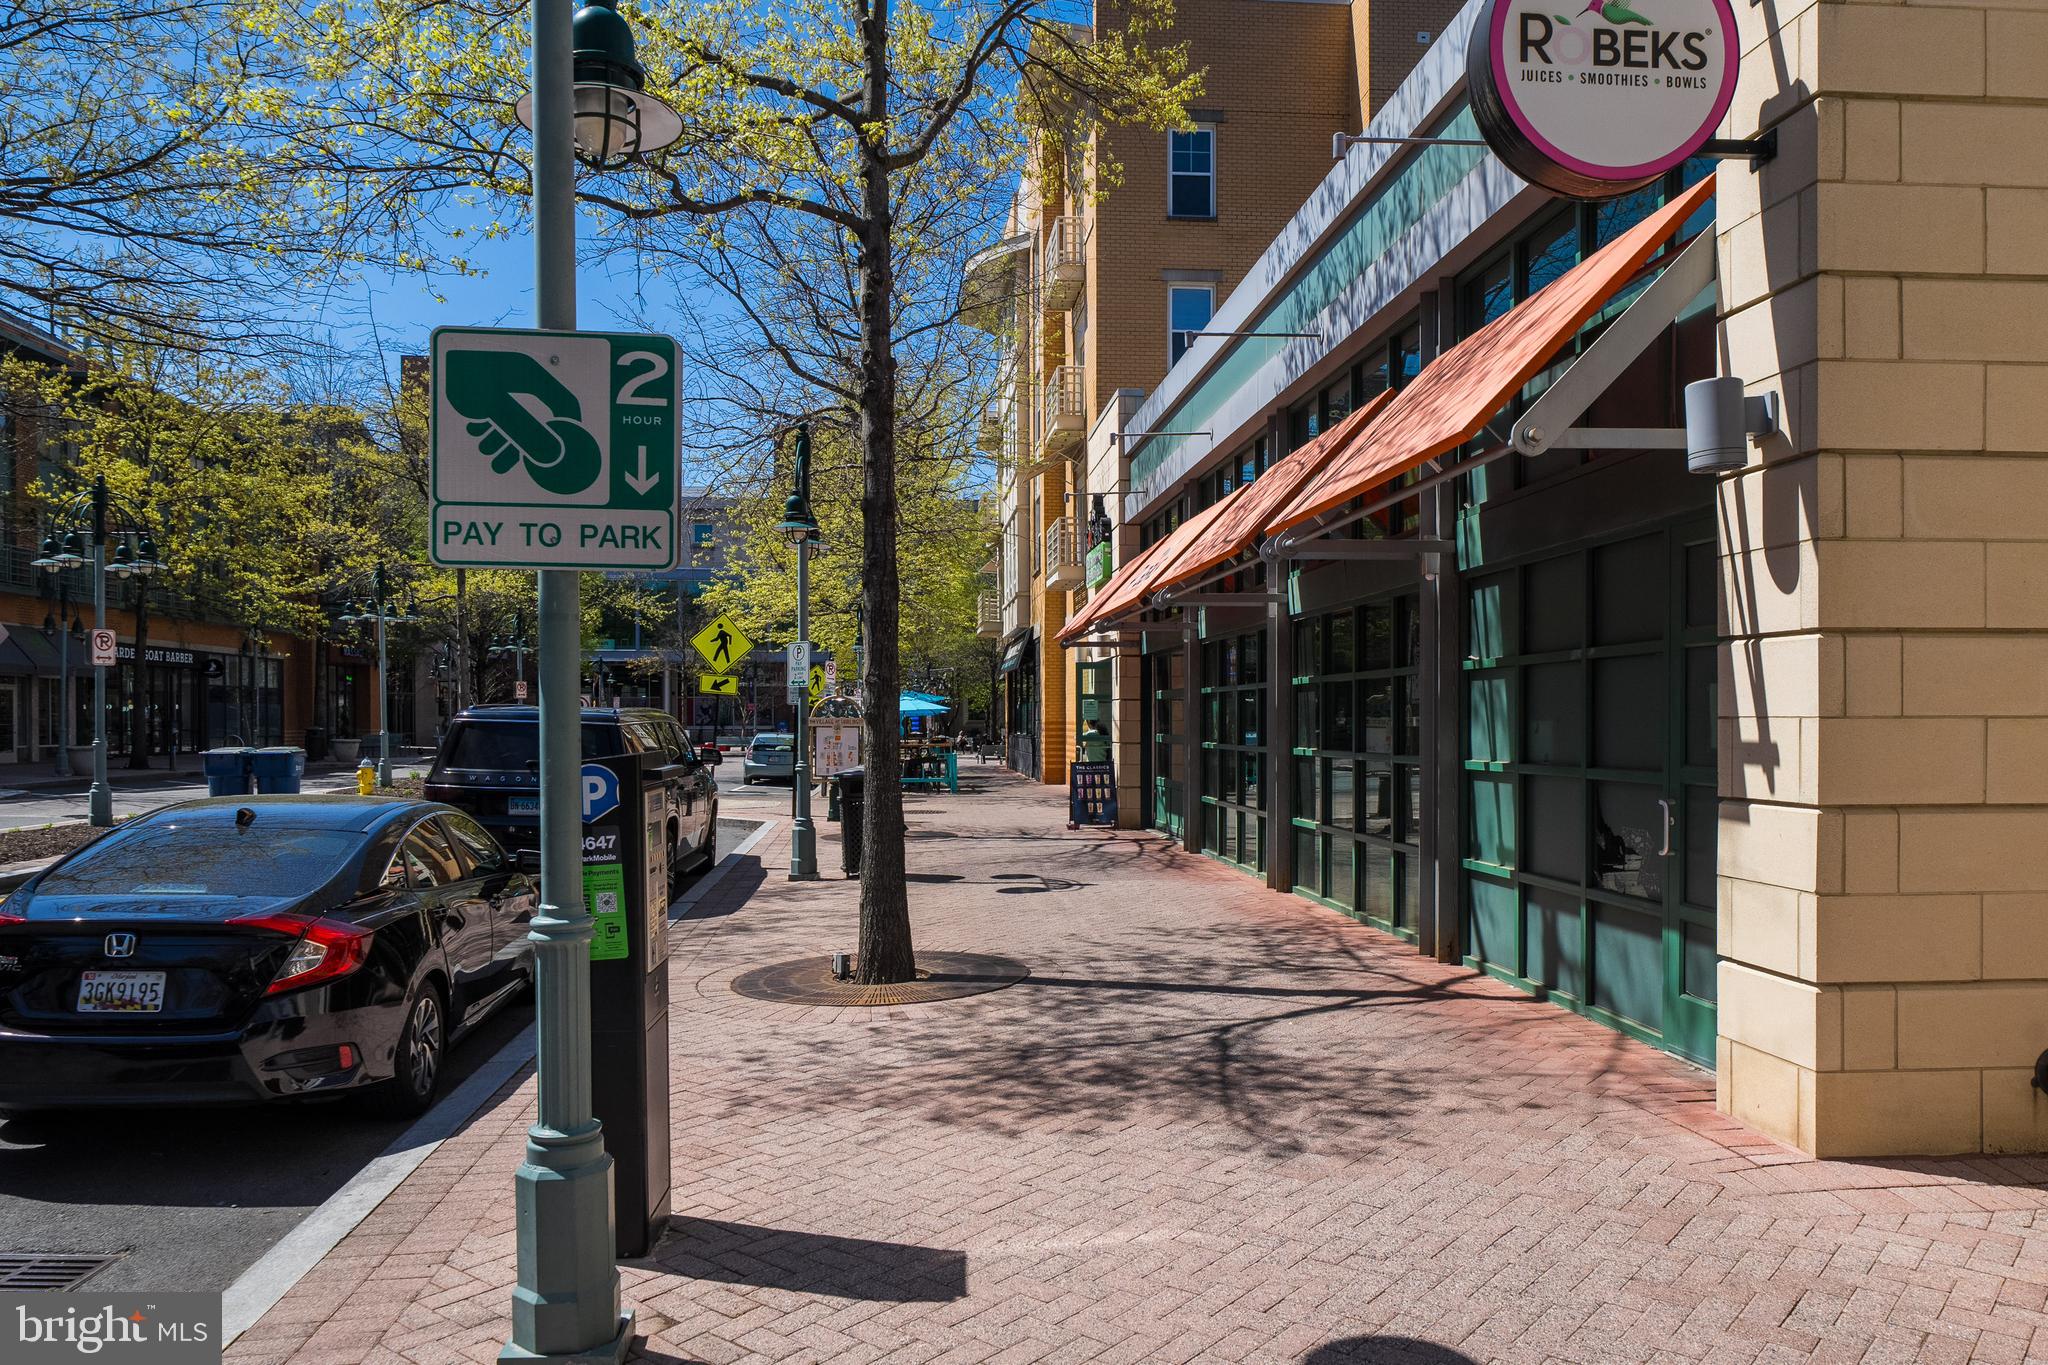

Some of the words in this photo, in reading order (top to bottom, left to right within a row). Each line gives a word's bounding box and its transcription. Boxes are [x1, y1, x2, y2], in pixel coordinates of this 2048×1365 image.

[1520, 69, 1562, 83] JUICES
[1580, 72, 1649, 87] SMOOTHIES
[1666, 76, 1707, 89] BOWLS
[616, 350, 669, 407] 2
[622, 415, 662, 425] HOUR
[443, 521, 504, 546] PAY
[519, 522, 562, 548] TO
[580, 524, 662, 550] PARK
[165, 652, 194, 664] BARBER
[582, 854, 617, 862] arkMobile
[84, 982, 160, 1003] 3GK9195
